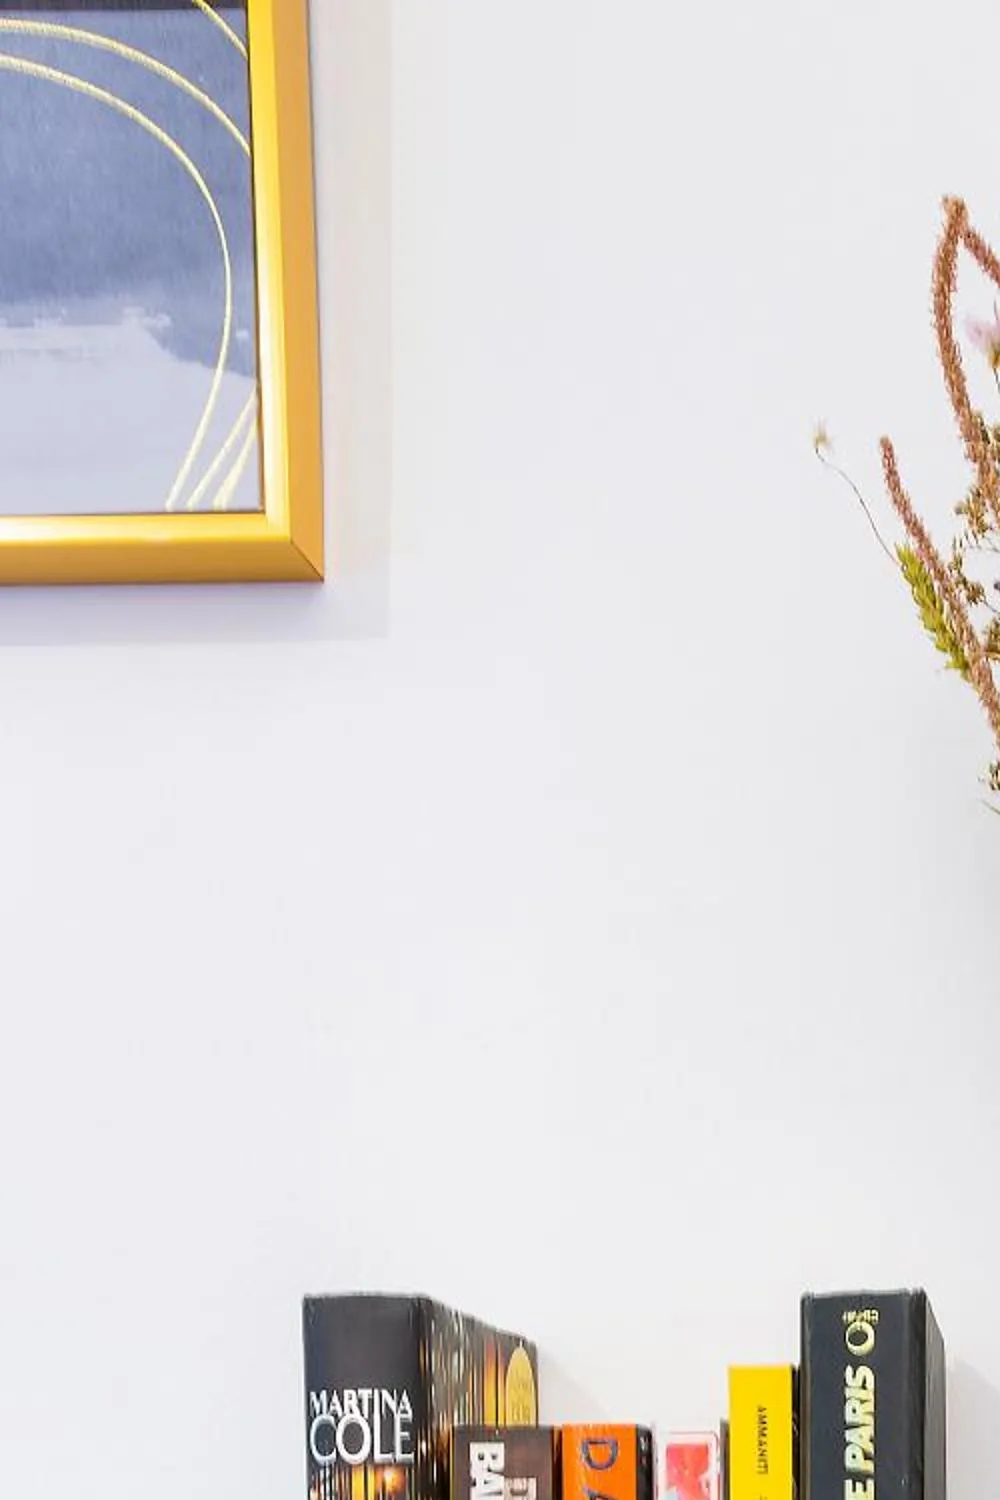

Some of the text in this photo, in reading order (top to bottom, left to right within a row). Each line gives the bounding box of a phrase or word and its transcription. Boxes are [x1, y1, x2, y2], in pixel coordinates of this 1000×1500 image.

[310, 1388, 413, 1420] MARTINA
[845, 1365, 875, 1472] PARIS
[310, 1413, 415, 1465] COLE
